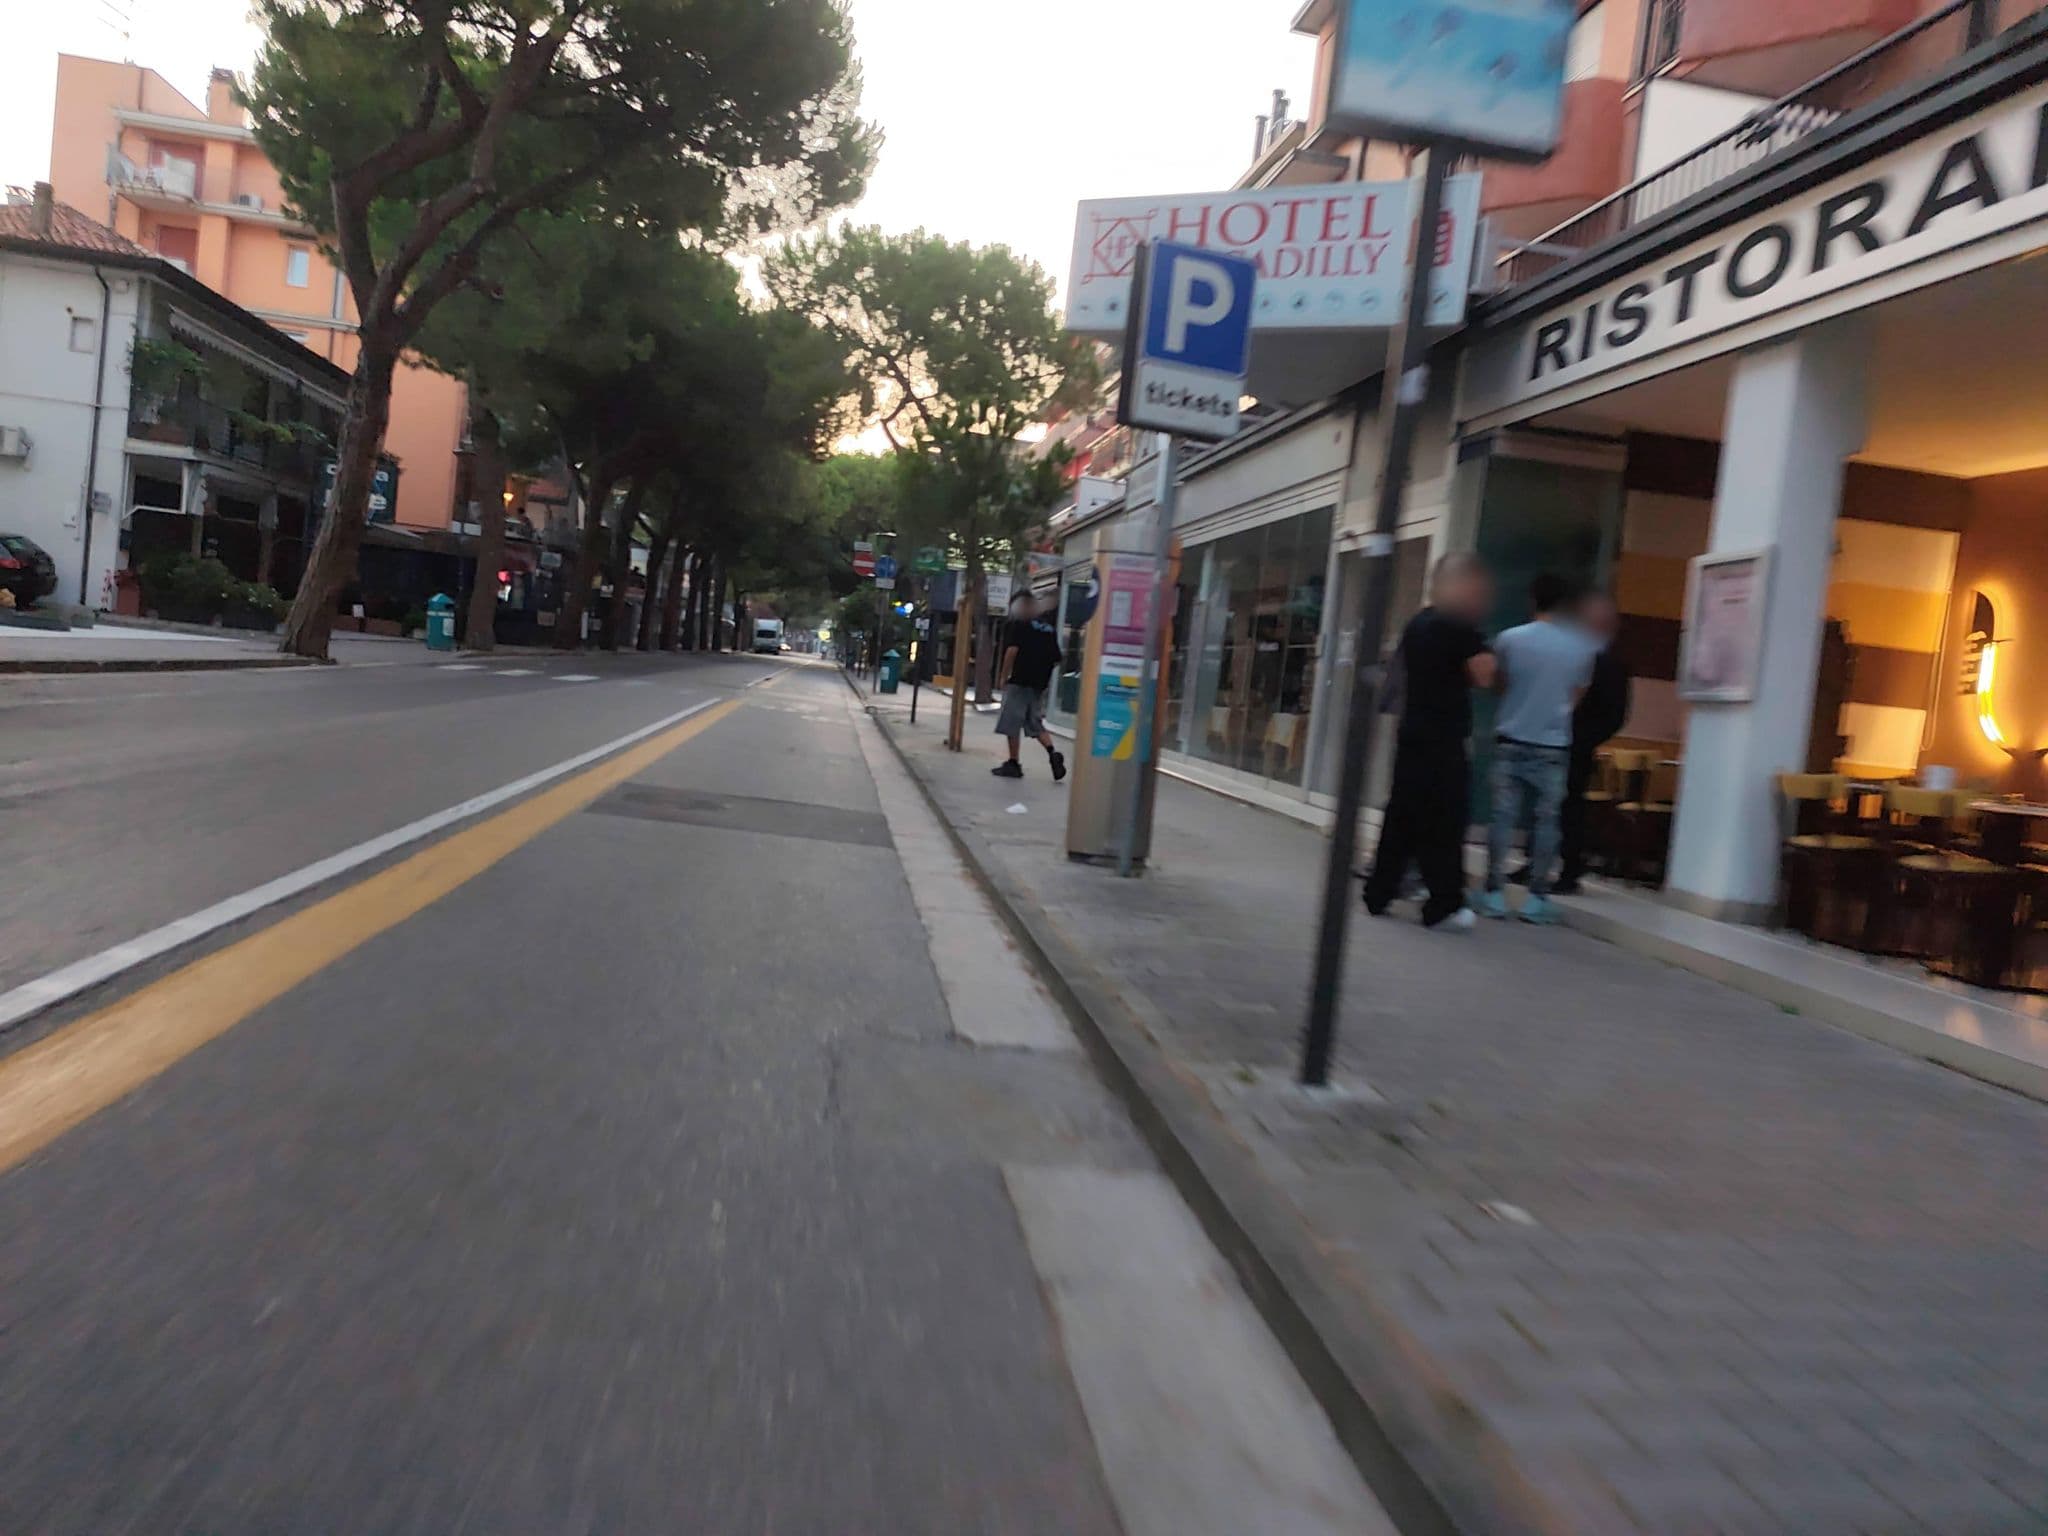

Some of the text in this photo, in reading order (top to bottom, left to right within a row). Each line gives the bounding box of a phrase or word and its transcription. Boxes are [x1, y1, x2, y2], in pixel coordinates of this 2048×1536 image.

[1169, 194, 1391, 246] HOTEL
[1225, 243, 1390, 280] ADILLY
[1164, 257, 1235, 353] P
[1145, 381, 1232, 417] tickets
